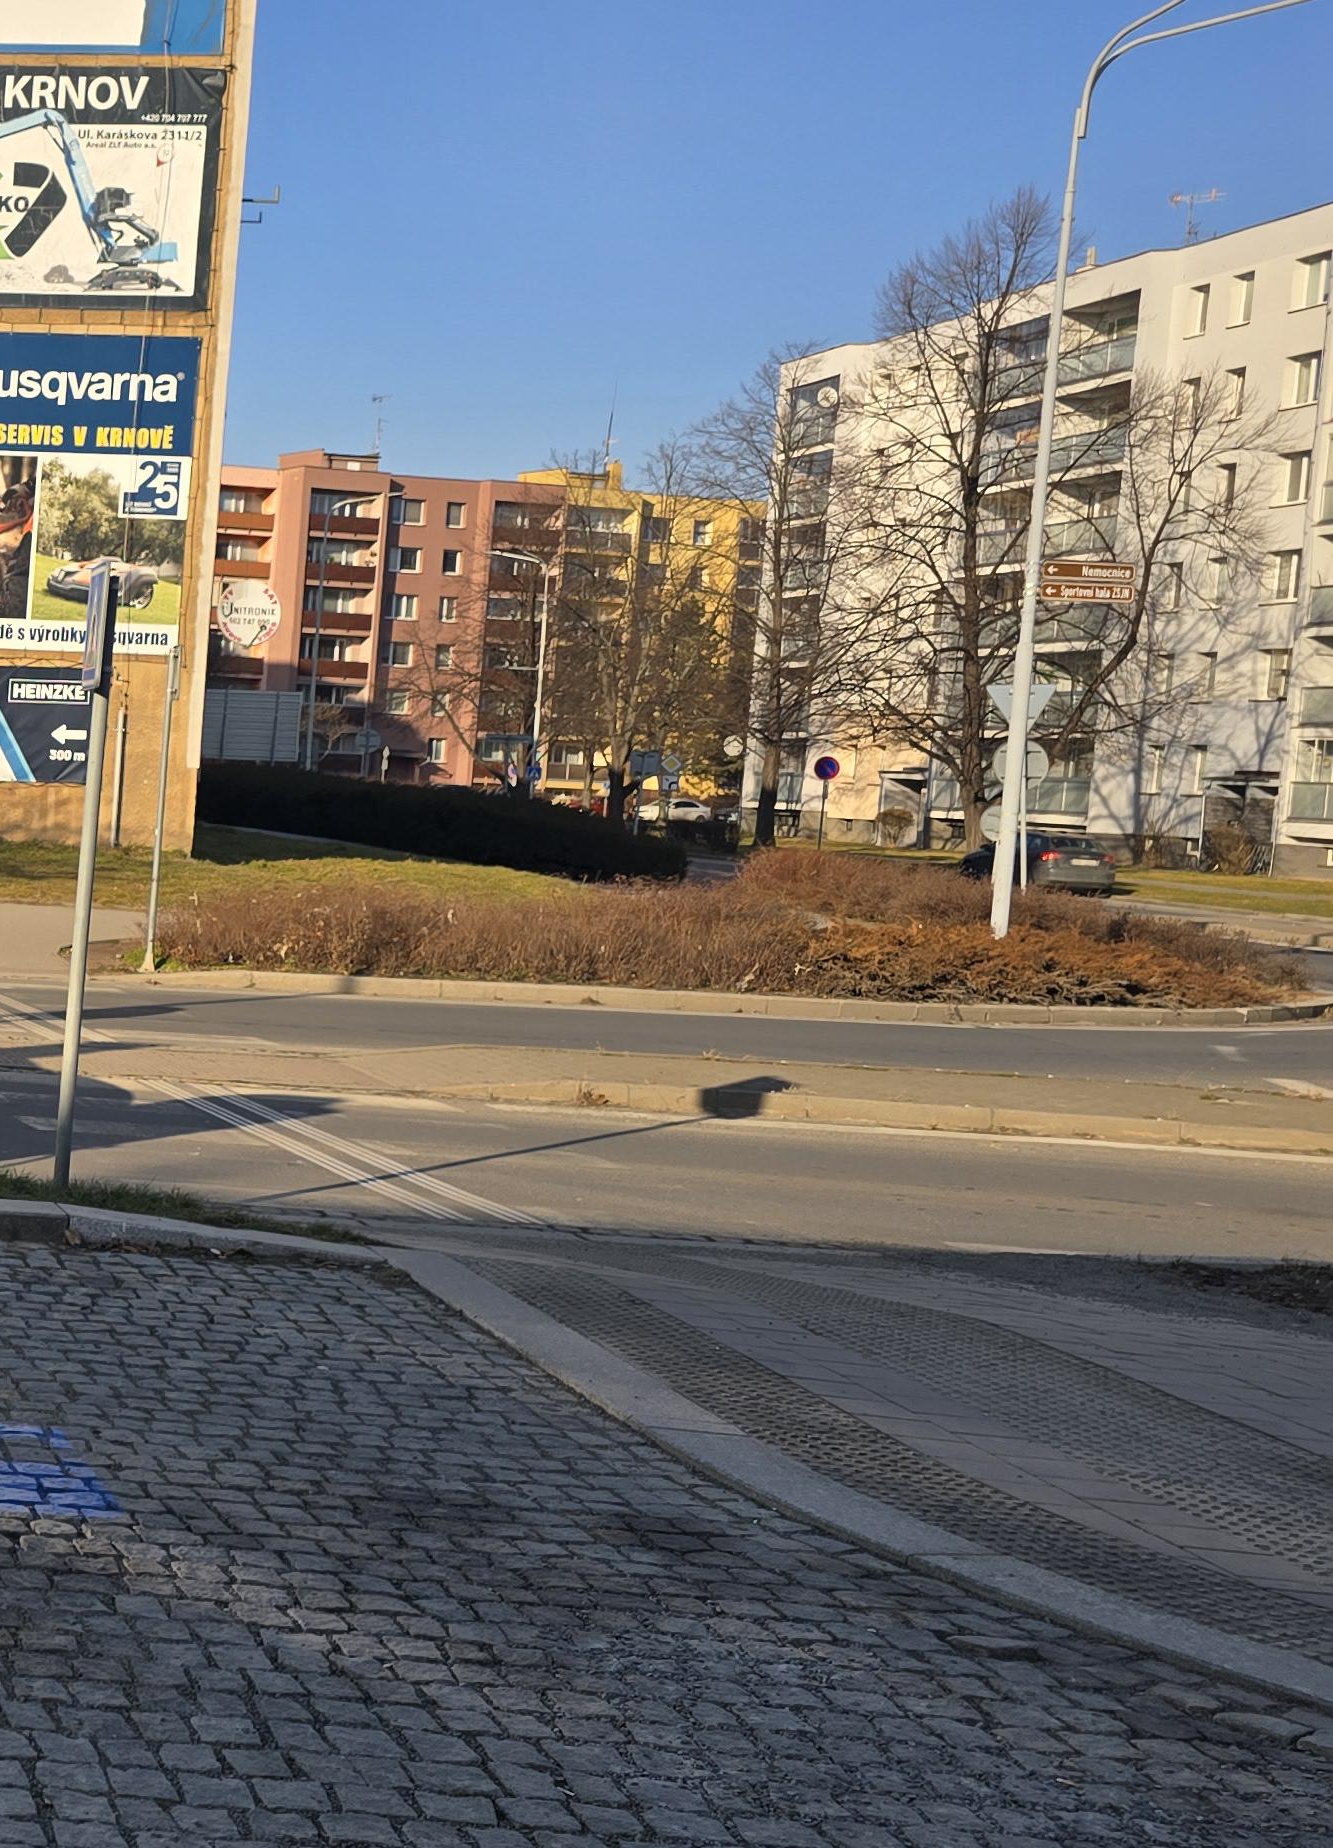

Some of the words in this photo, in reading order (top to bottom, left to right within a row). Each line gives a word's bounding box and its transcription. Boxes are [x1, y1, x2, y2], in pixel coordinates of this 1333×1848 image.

[4, 74, 149, 110] KRNOV
[96, 129, 158, 140] Karáskova
[73, 426, 88, 446] V
[95, 425, 175, 450] KRNOVĚ
[1081, 565, 1131, 579] Nemocnice
[17, 628, 25, 640] s
[29, 625, 87, 644] výrobky
[12, 683, 86, 700] HEINZKE
[74, 752, 86, 761] m
